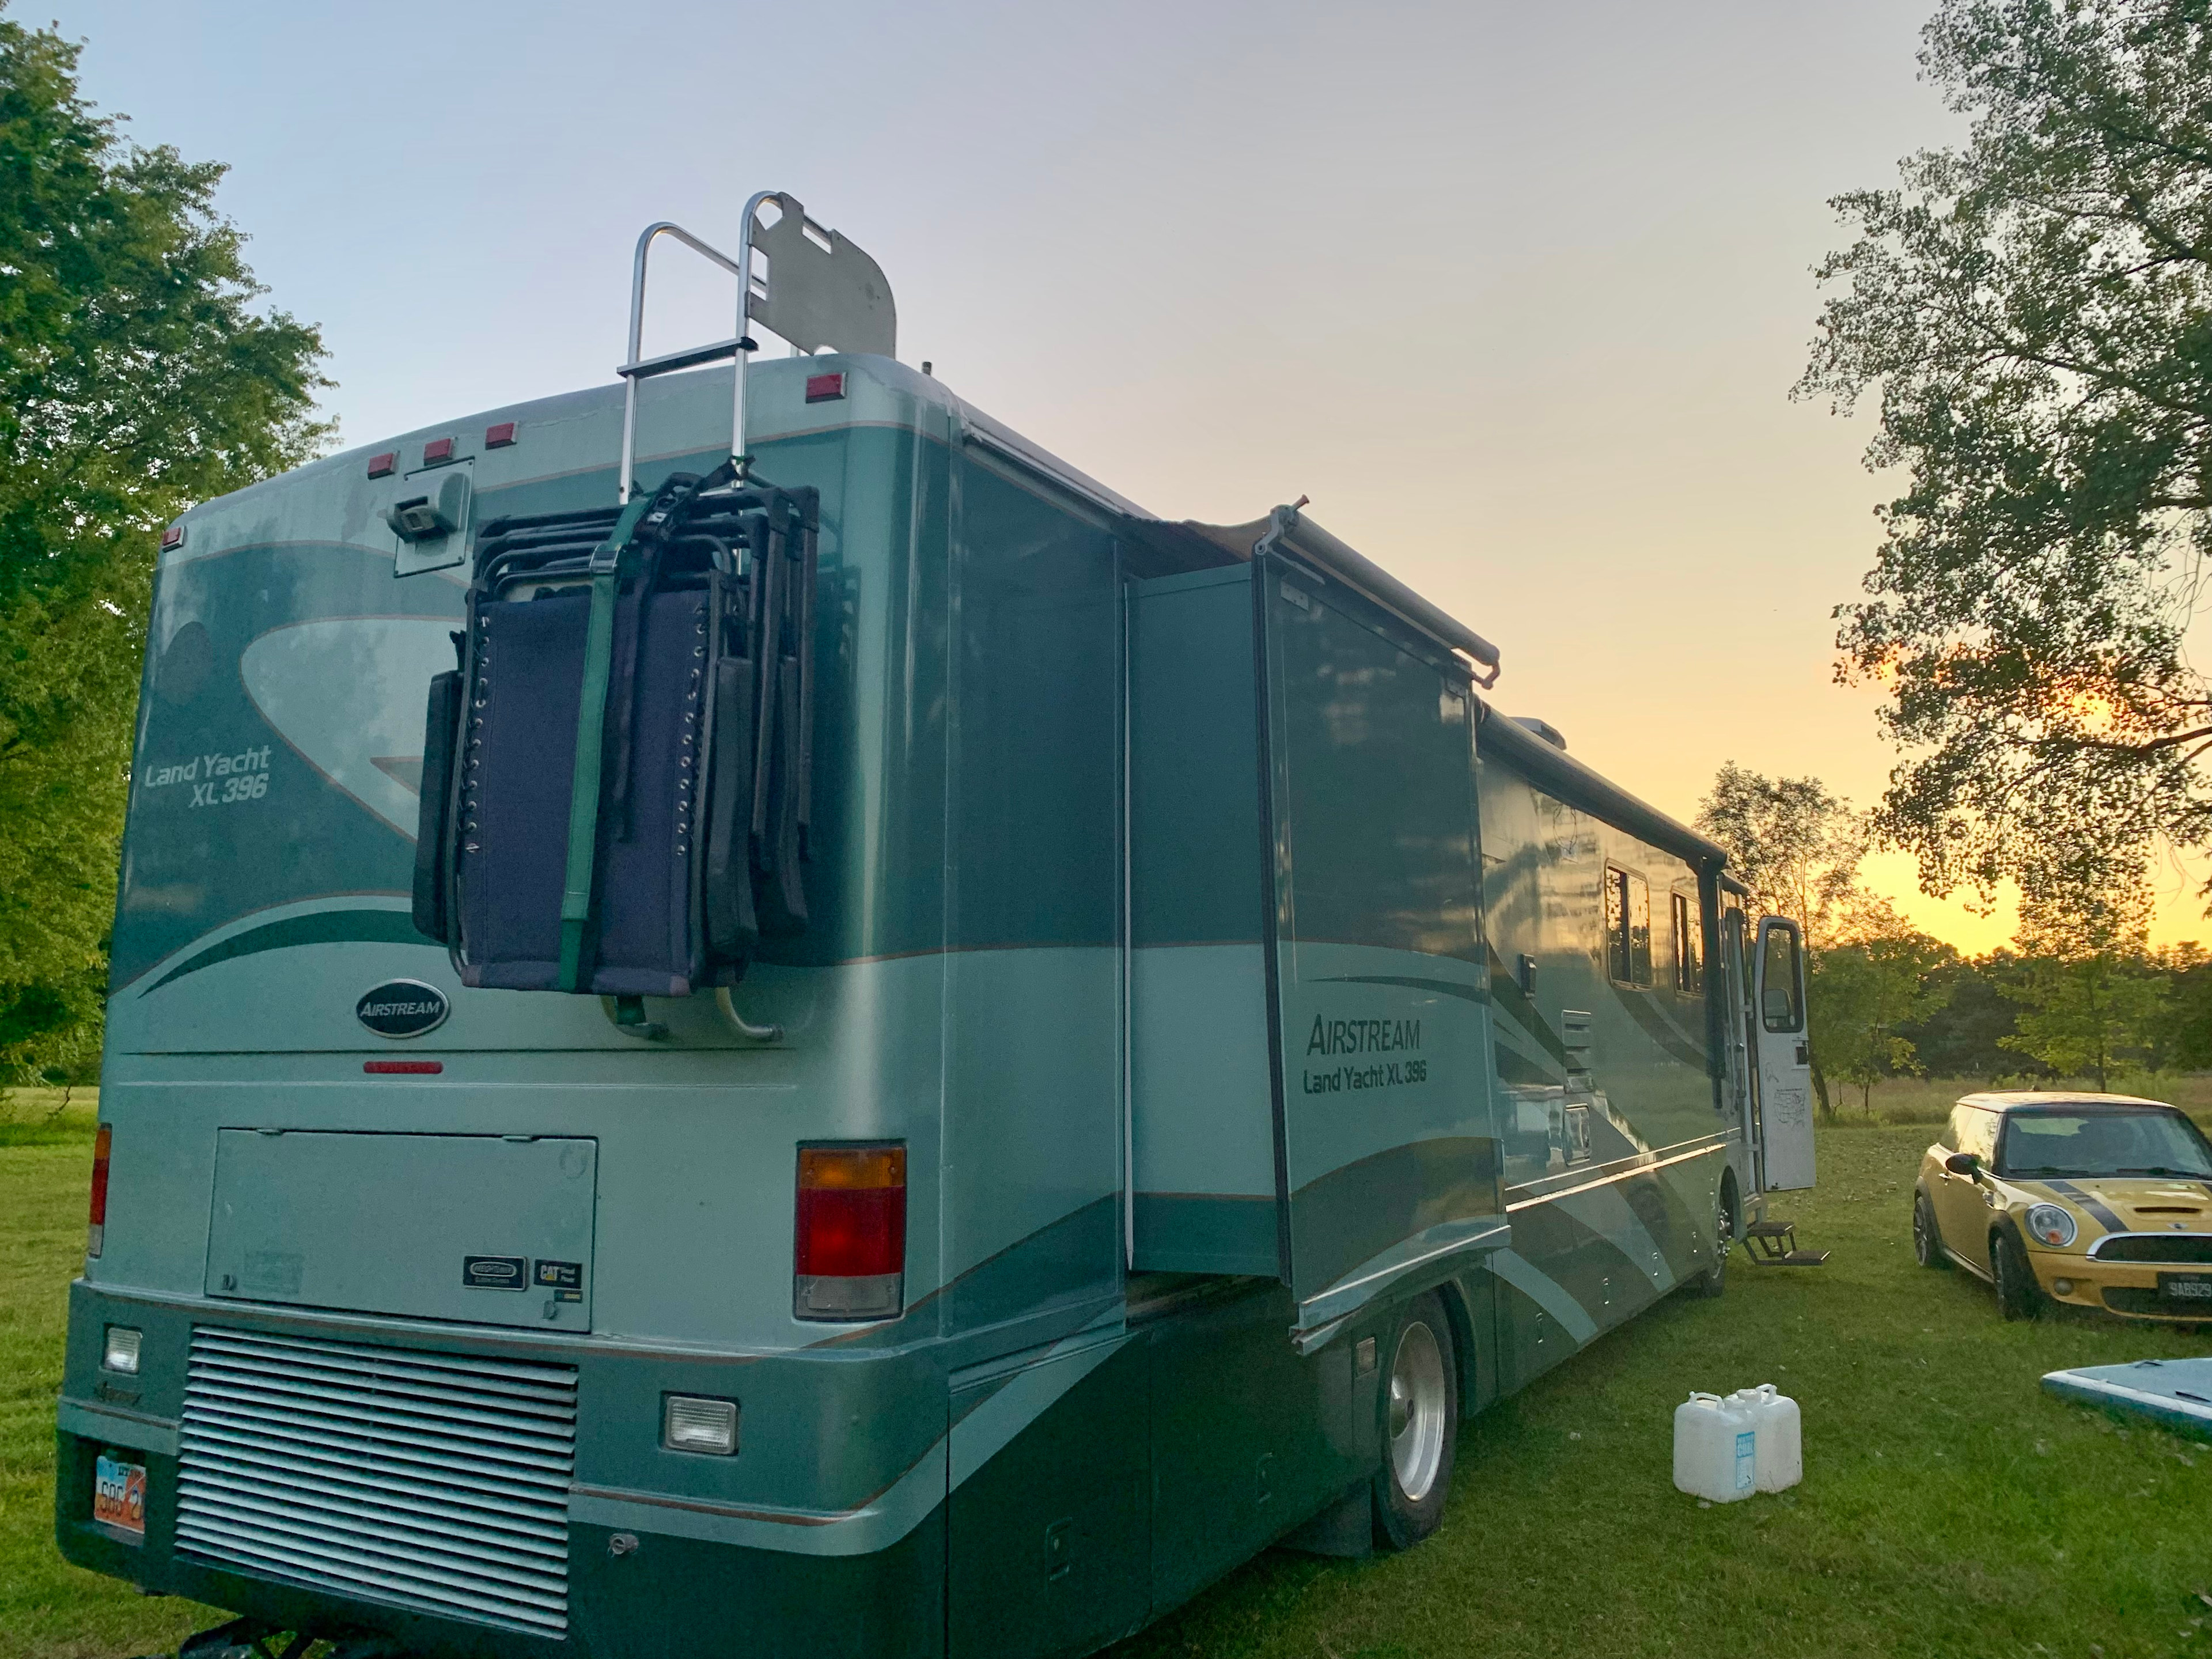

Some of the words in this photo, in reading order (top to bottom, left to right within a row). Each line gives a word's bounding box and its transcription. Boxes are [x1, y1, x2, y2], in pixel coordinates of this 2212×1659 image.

[145, 756, 199, 787] Land
[203, 745, 272, 777] Yacht
[188, 782, 218, 808] XL
[222, 772, 270, 803] 396
[359, 1001, 441, 1017] AIRSTREAM
[1306, 1013, 1421, 1056] AIRSTREAM
[1303, 1066, 1341, 1094] Land
[1343, 1065, 1384, 1090] Yacht
[1386, 1063, 1403, 1086] XL
[1404, 1059, 1427, 1084] 396
[540, 1264, 559, 1281] CAT
